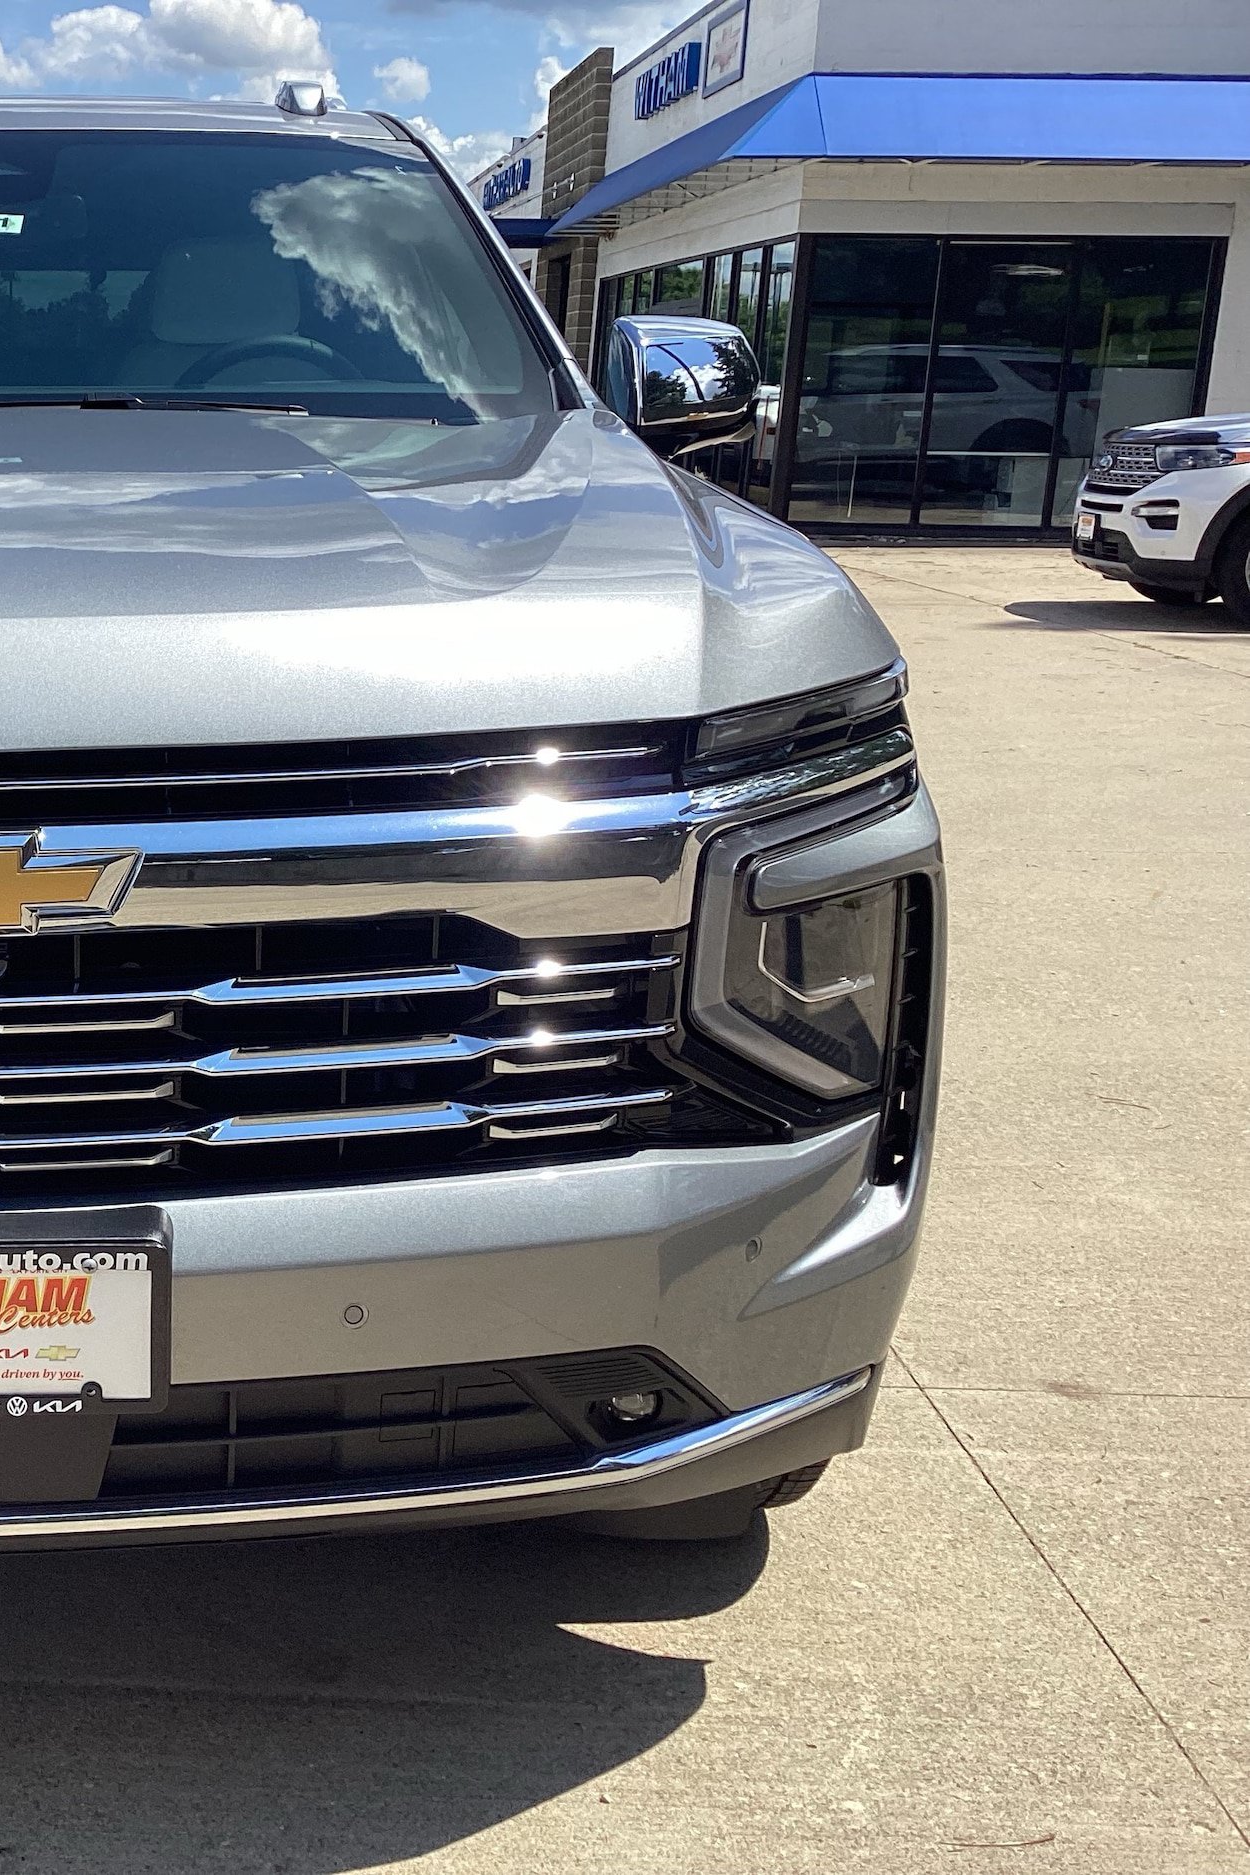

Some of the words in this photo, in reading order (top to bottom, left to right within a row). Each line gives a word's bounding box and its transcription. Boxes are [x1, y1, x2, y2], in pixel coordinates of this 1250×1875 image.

[634, 42, 701, 120] WITHAM
[1, 1369, 40, 1379] driven
[42, 1368, 57, 1381] by
[58, 1370, 84, 1381] you.
